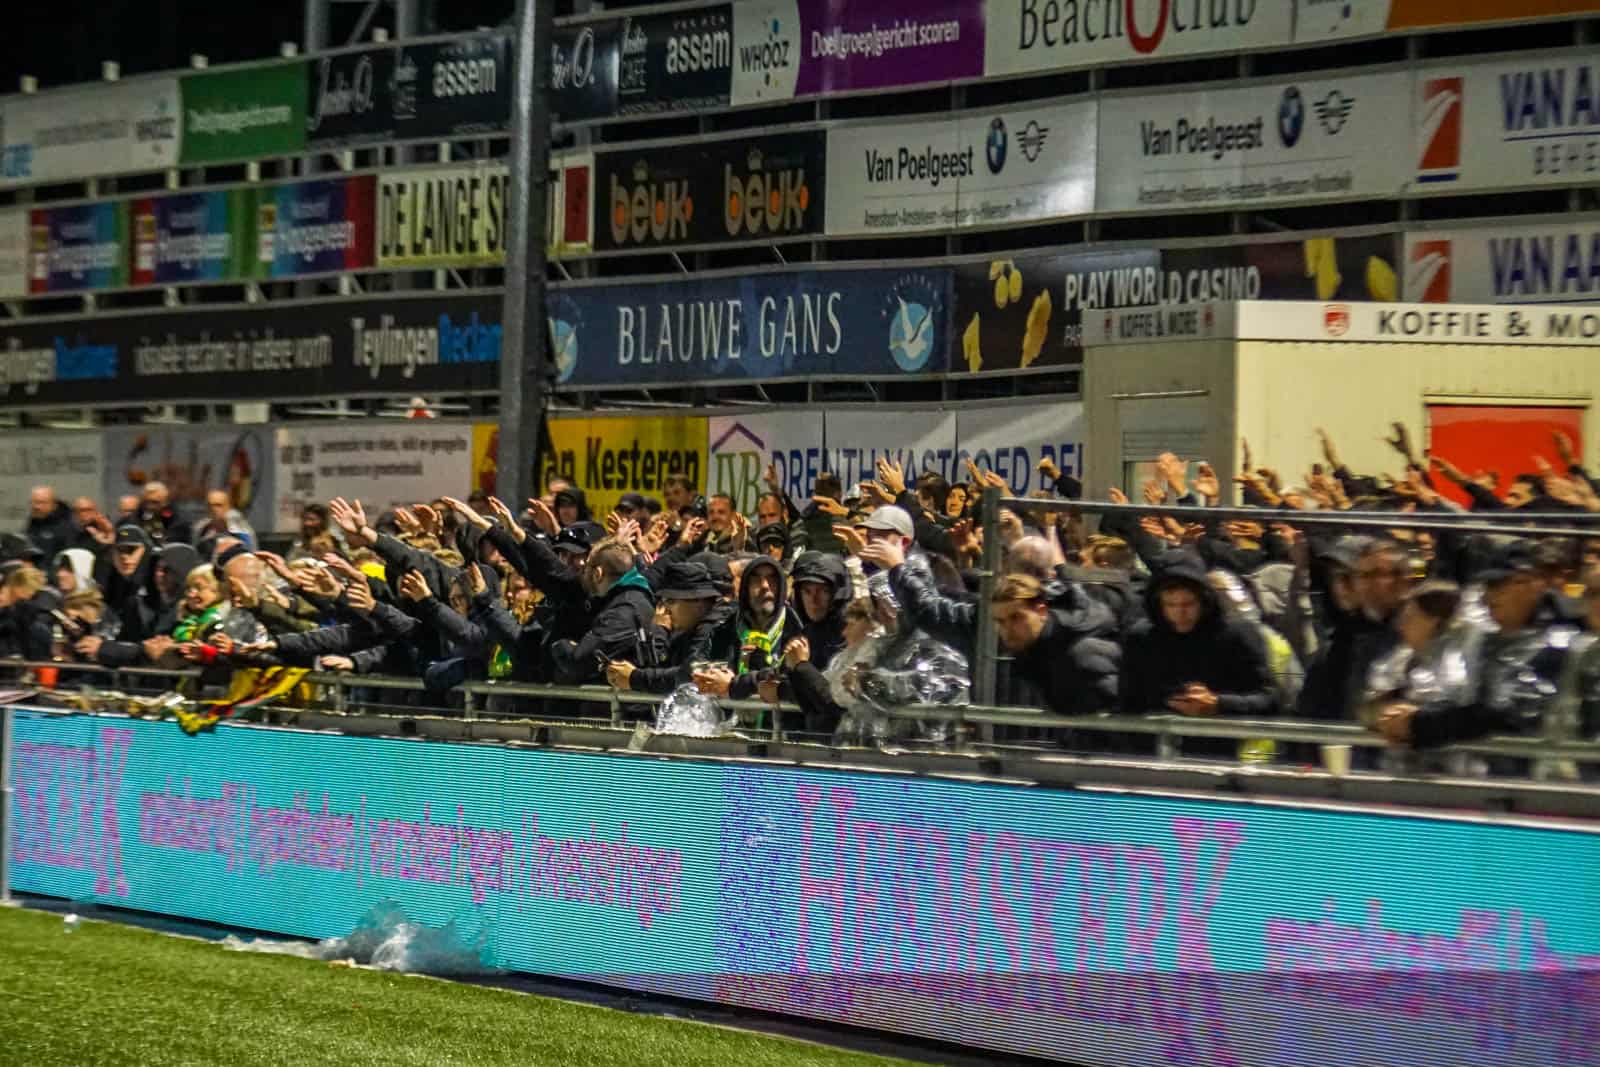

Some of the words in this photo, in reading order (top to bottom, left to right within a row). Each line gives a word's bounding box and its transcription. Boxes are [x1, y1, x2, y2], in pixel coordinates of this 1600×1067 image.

[667, 30, 731, 75] assem
[918, 19, 961, 46] scoren
[432, 58, 497, 98] assem
[740, 40, 790, 73] WHOOZ
[1499, 68, 1567, 132] VAN
[1140, 118, 1172, 157] Van
[1174, 115, 1265, 161] Poelgeest
[865, 149, 894, 183] Van
[897, 144, 975, 188] Poelgeest
[1185, 264, 1262, 302] CASINO
[1488, 237, 1552, 297] VAN
[618, 299, 742, 365] BLAUWE
[759, 292, 842, 356] GANS
[1376, 311, 1491, 336] KOFFIE
[1506, 311, 1531, 337] &
[586, 437, 700, 491] Kesteren
